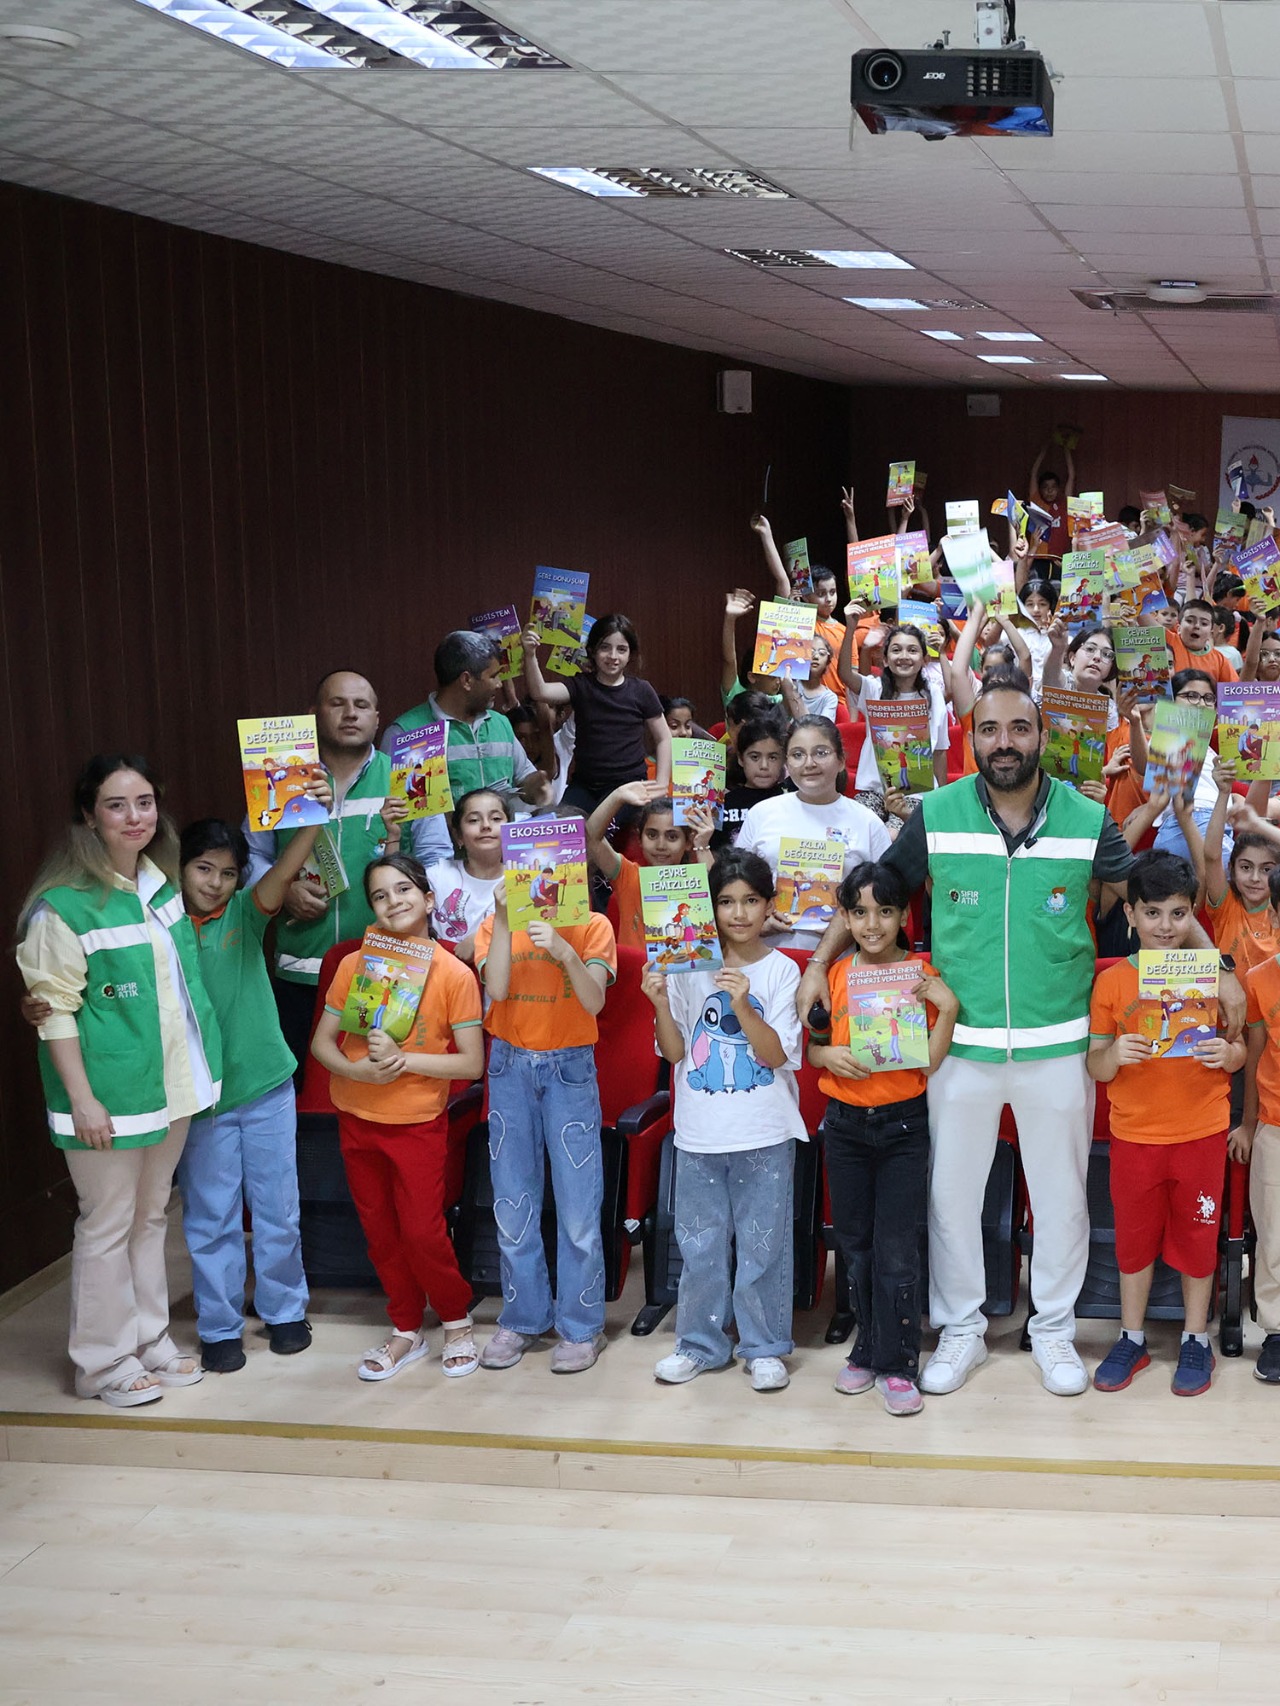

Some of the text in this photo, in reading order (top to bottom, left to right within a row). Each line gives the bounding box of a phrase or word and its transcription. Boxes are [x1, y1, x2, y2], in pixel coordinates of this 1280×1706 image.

[1127, 629, 1150, 639] ÇEVRE
[1224, 683, 1280, 696] EKOSİSTEM
[396, 724, 441, 746] EKOSİSTEM
[691, 741, 716, 751] ÇEVRE
[509, 822, 578, 838] EKOSİSTEM
[657, 867, 687, 879] ÇEVRE
[116, 982, 137, 991] SIFIR
[118, 990, 139, 998] ATIK
